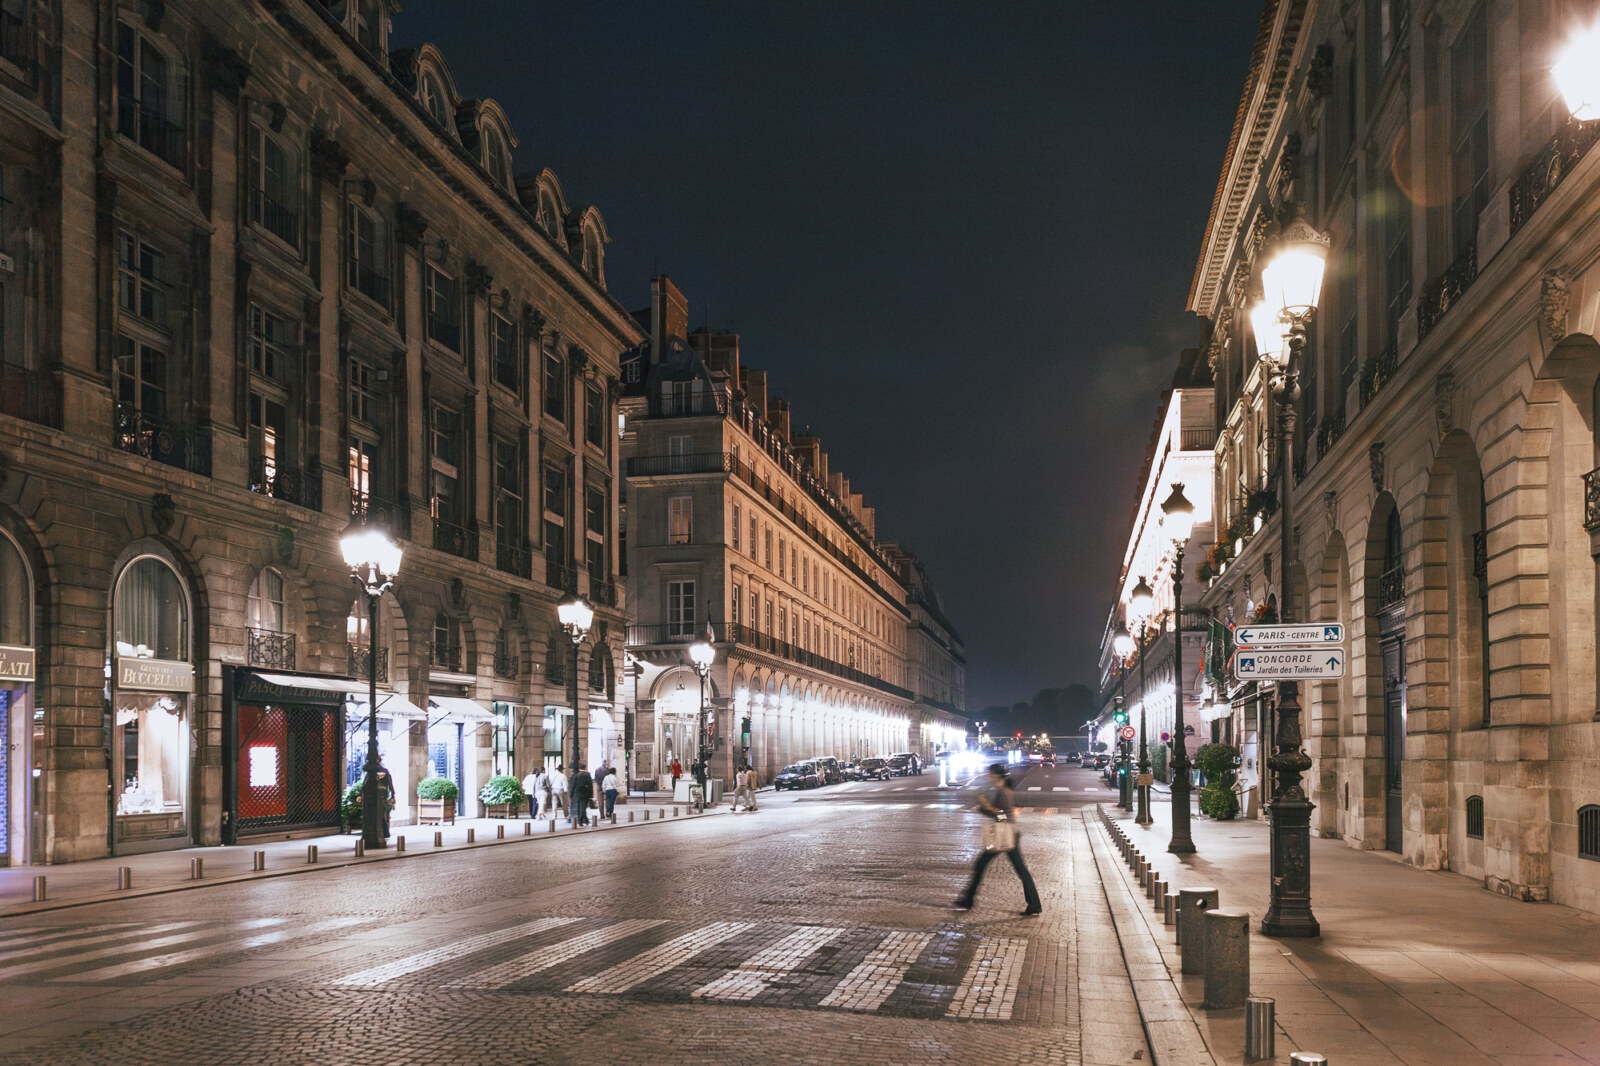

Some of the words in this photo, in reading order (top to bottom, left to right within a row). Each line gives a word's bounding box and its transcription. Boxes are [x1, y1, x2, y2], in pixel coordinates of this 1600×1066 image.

[1257, 655, 1312, 663] CONCORDE
[1257, 666, 1279, 674] Jardin
[1280, 666, 1292, 674] des
[1294, 666, 1323, 674] Tuileries
[123, 668, 188, 687] BUCCELLATI
